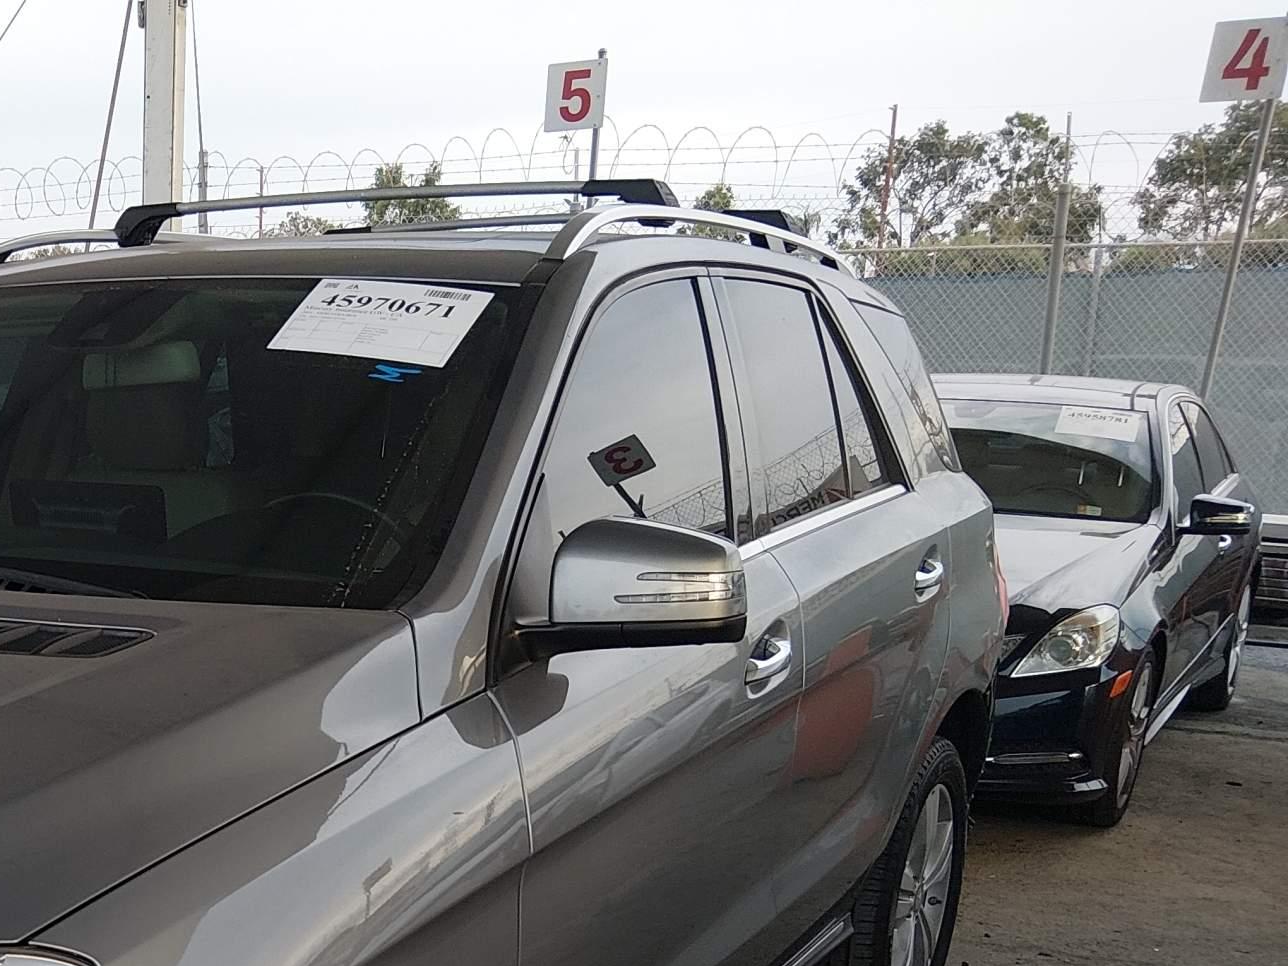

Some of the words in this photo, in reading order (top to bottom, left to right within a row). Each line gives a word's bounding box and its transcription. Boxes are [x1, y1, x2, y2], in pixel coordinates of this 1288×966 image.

[1221, 28, 1270, 91] 4
[559, 68, 592, 123] 5
[321, 293, 456, 318] 45970671
